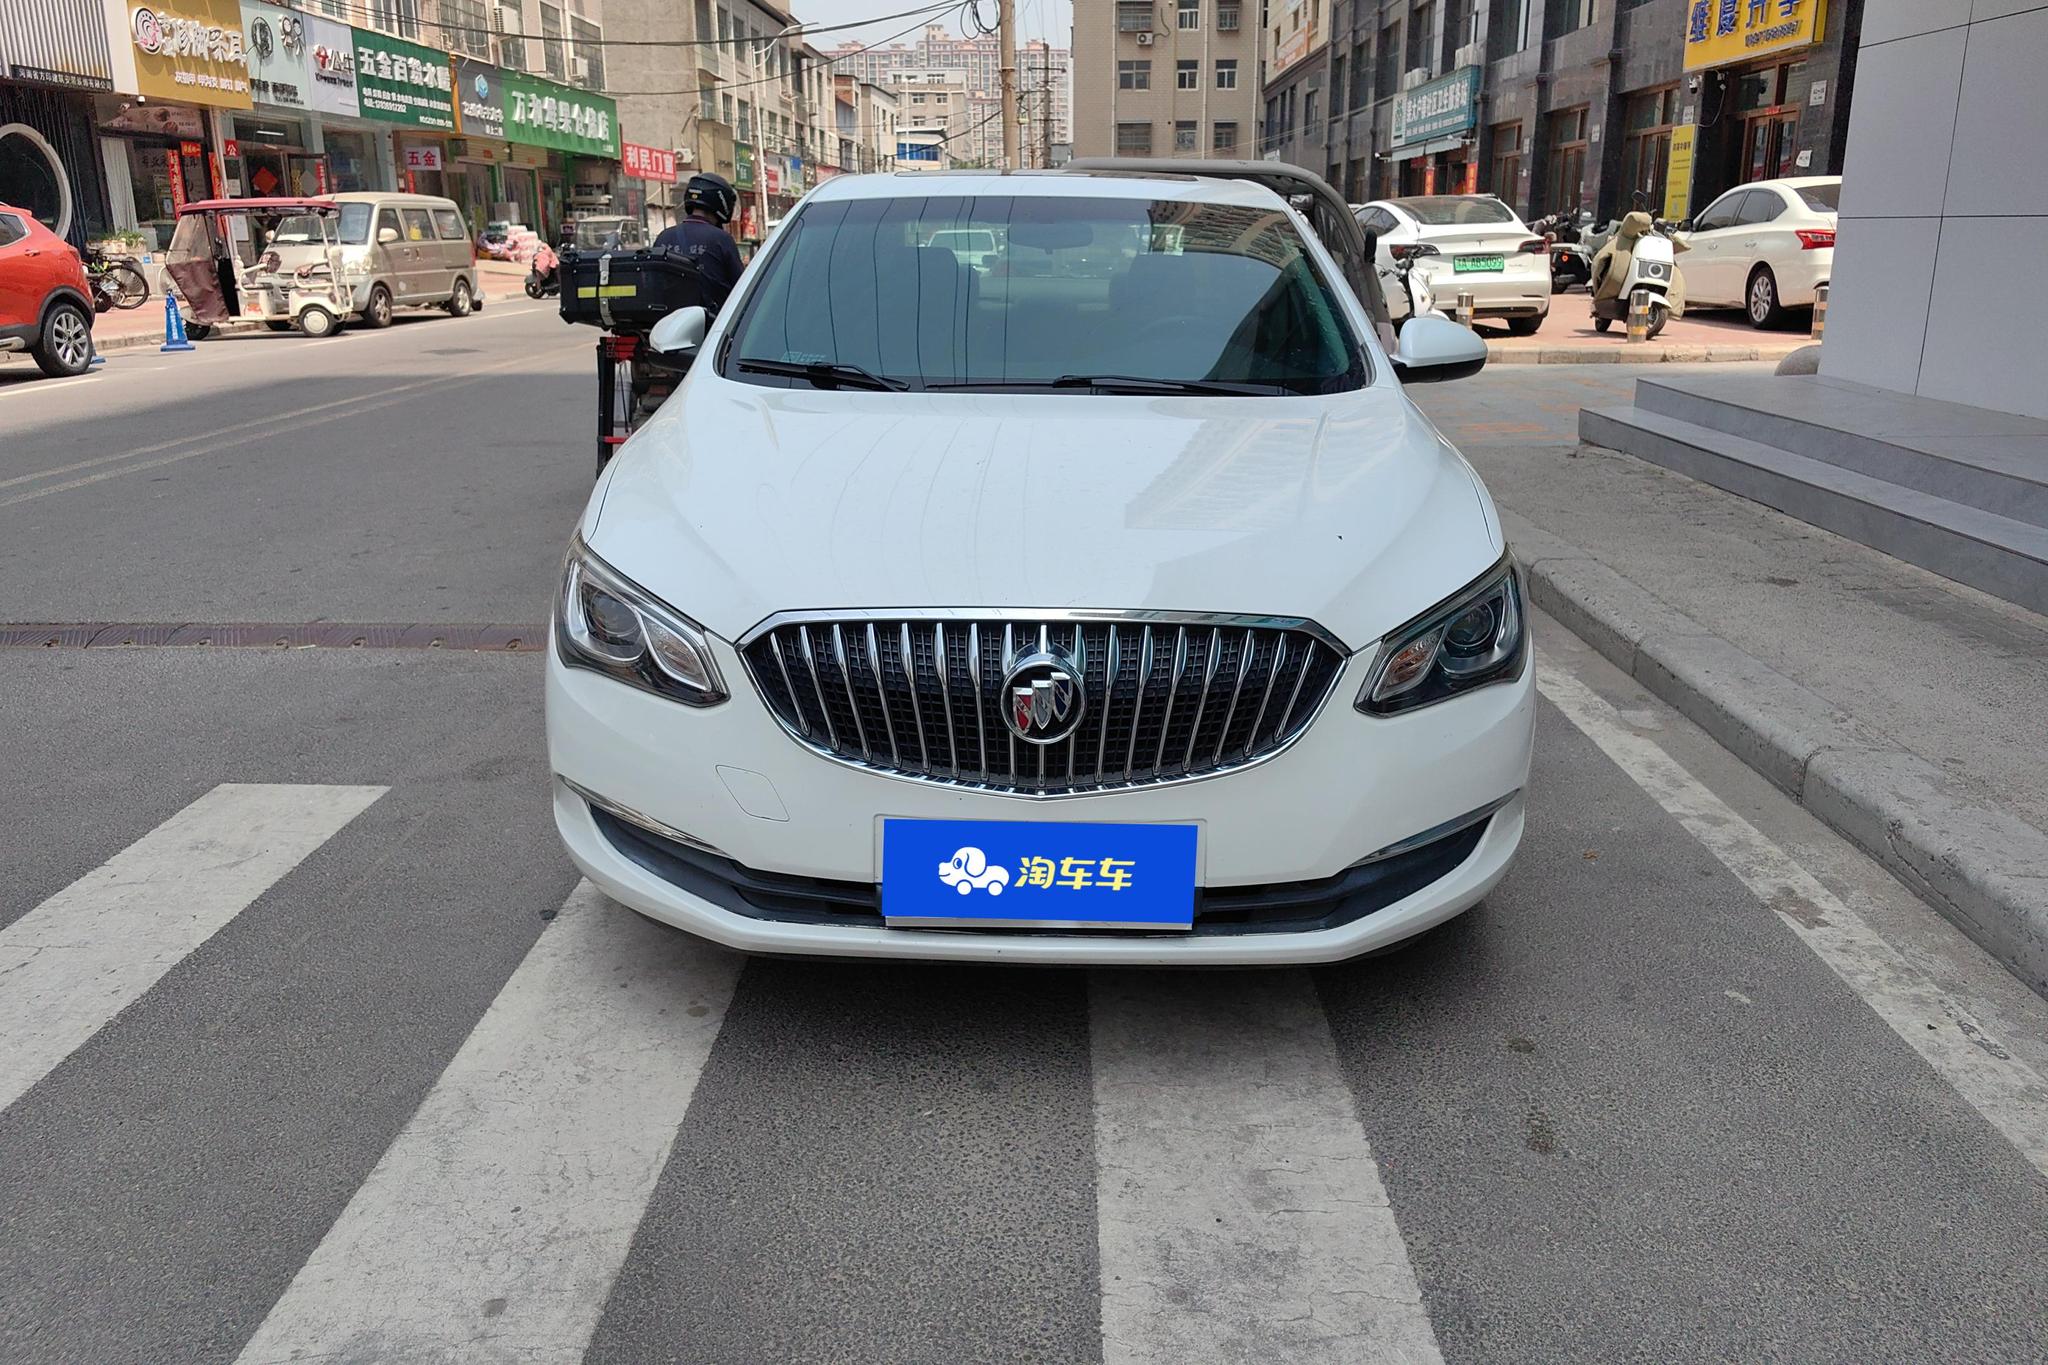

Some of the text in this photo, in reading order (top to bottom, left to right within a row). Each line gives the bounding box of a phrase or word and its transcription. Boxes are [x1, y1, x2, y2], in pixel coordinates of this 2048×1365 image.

[407, 151, 436, 167] 五金
[626, 146, 674, 175] 利民门窗
